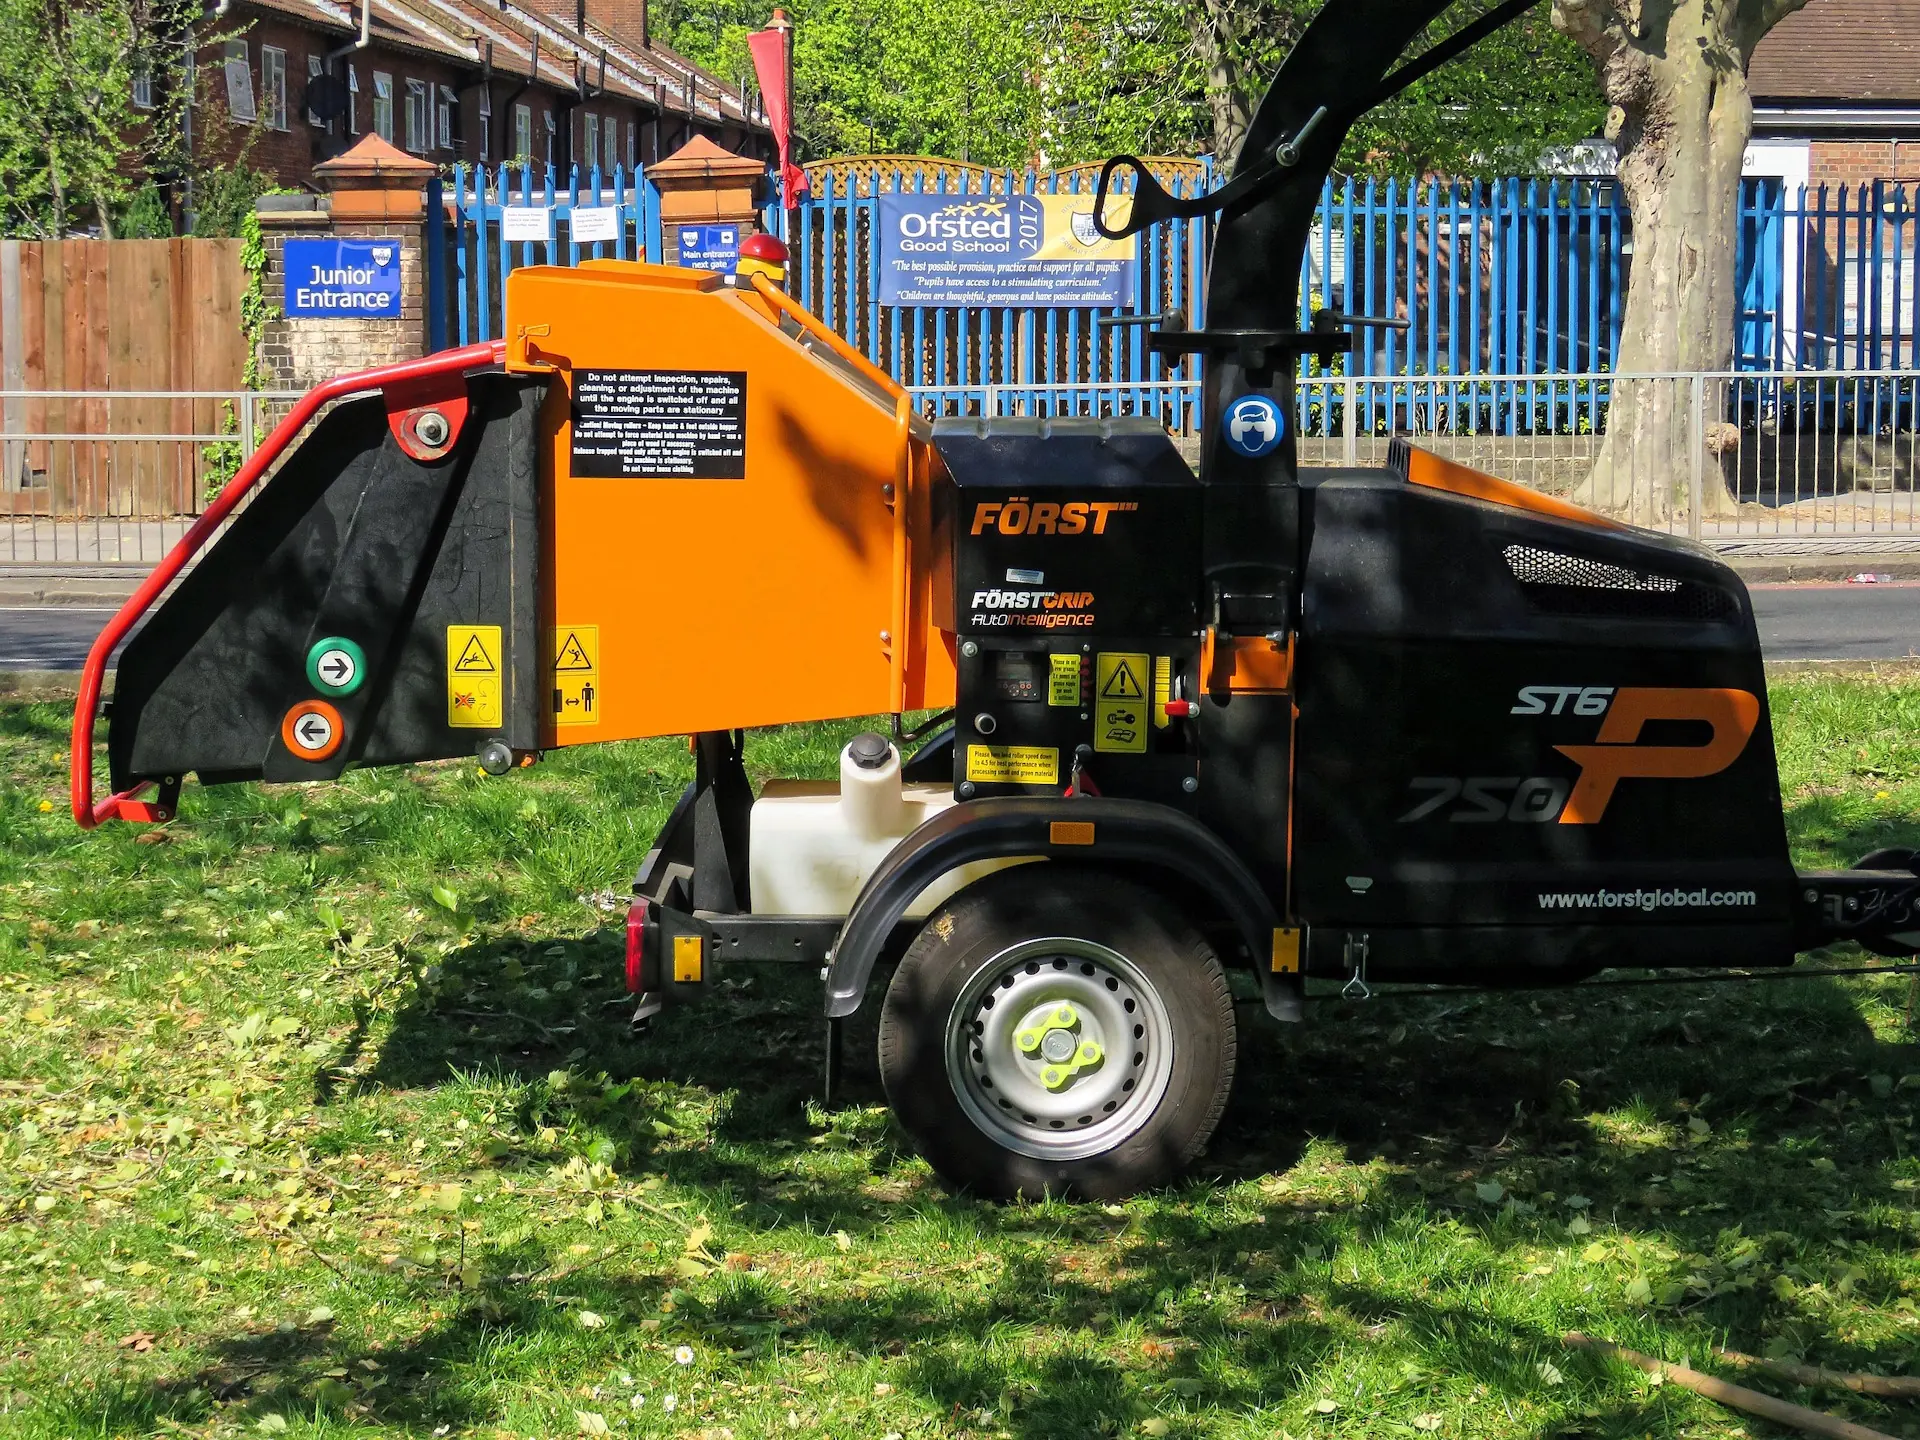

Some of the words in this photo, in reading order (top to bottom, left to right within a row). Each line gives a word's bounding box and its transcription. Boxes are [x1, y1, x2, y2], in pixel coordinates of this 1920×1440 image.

[900, 212, 1011, 239] Ofsted
[1019, 200, 1038, 250] 2017
[900, 239, 946, 252] Good
[952, 240, 1009, 253] School
[682, 250, 701, 259] Main
[702, 250, 736, 259] entrance
[691, 260, 709, 269] next
[710, 260, 728, 270] gate
[911, 260, 926, 271] best
[927, 261, 957, 274] possible
[958, 261, 995, 274] provision,
[997, 262, 1027, 275] practice
[1027, 262, 1042, 272] and
[1042, 263, 1071, 275] support
[1071, 262, 1083, 275] for
[1085, 262, 1094, 272] all
[309, 265, 375, 285] Junior
[945, 277, 964, 287] have
[966, 278, 990, 287] access
[992, 278, 1000, 287] to
[1001, 279, 1006, 287] a
[1008, 277, 1053, 289] stimulating
[297, 288, 390, 308] Entrance
[933, 293, 945, 301] are
[946, 291, 986, 303] thoughtful,
[987, 292, 1019, 304] generous
[1020, 291, 1034, 301] and
[1035, 291, 1052, 301] have
[1053, 292, 1081, 303] positive
[588, 373, 600, 382] Do
[603, 374, 617, 382] not
[620, 374, 651, 383] attempt
[654, 374, 698, 384] inspection,
[701, 375, 731, 385] repairs,
[579, 384, 616, 393] cleaning,
[630, 385, 675, 394] adjustment
[678, 385, 687, 393] of
[690, 386, 703, 394] the
[706, 386, 740, 395] machine
[580, 394, 598, 402] until
[600, 394, 614, 402] the
[617, 395, 644, 404] engine
[647, 395, 654, 403] is
[657, 396, 693, 404] switched
[696, 396, 709, 404] off
[711, 396, 726, 404] and
[728, 396, 738, 404] all
[594, 404, 608, 412] the
[611, 405, 640, 414] moving
[643, 406, 664, 415] parts
[683, 406, 724, 415] stationary
[575, 430, 583, 438] Do
[594, 431, 616, 439] attempt
[640, 431, 663, 439] material
[699, 432, 706, 440] by
[573, 447, 595, 455] Release
[596, 447, 617, 456] trapped
[634, 448, 646, 456] only
[698, 448, 722, 456] switched
[970, 496, 1138, 535] FÖRST
[1025, 752, 1039, 760] speed
[1008, 761, 1037, 769] performance
[972, 769, 997, 777] processing
[1396, 777, 1570, 823] 750
[1538, 888, 1756, 912] www.forstglobal.com
